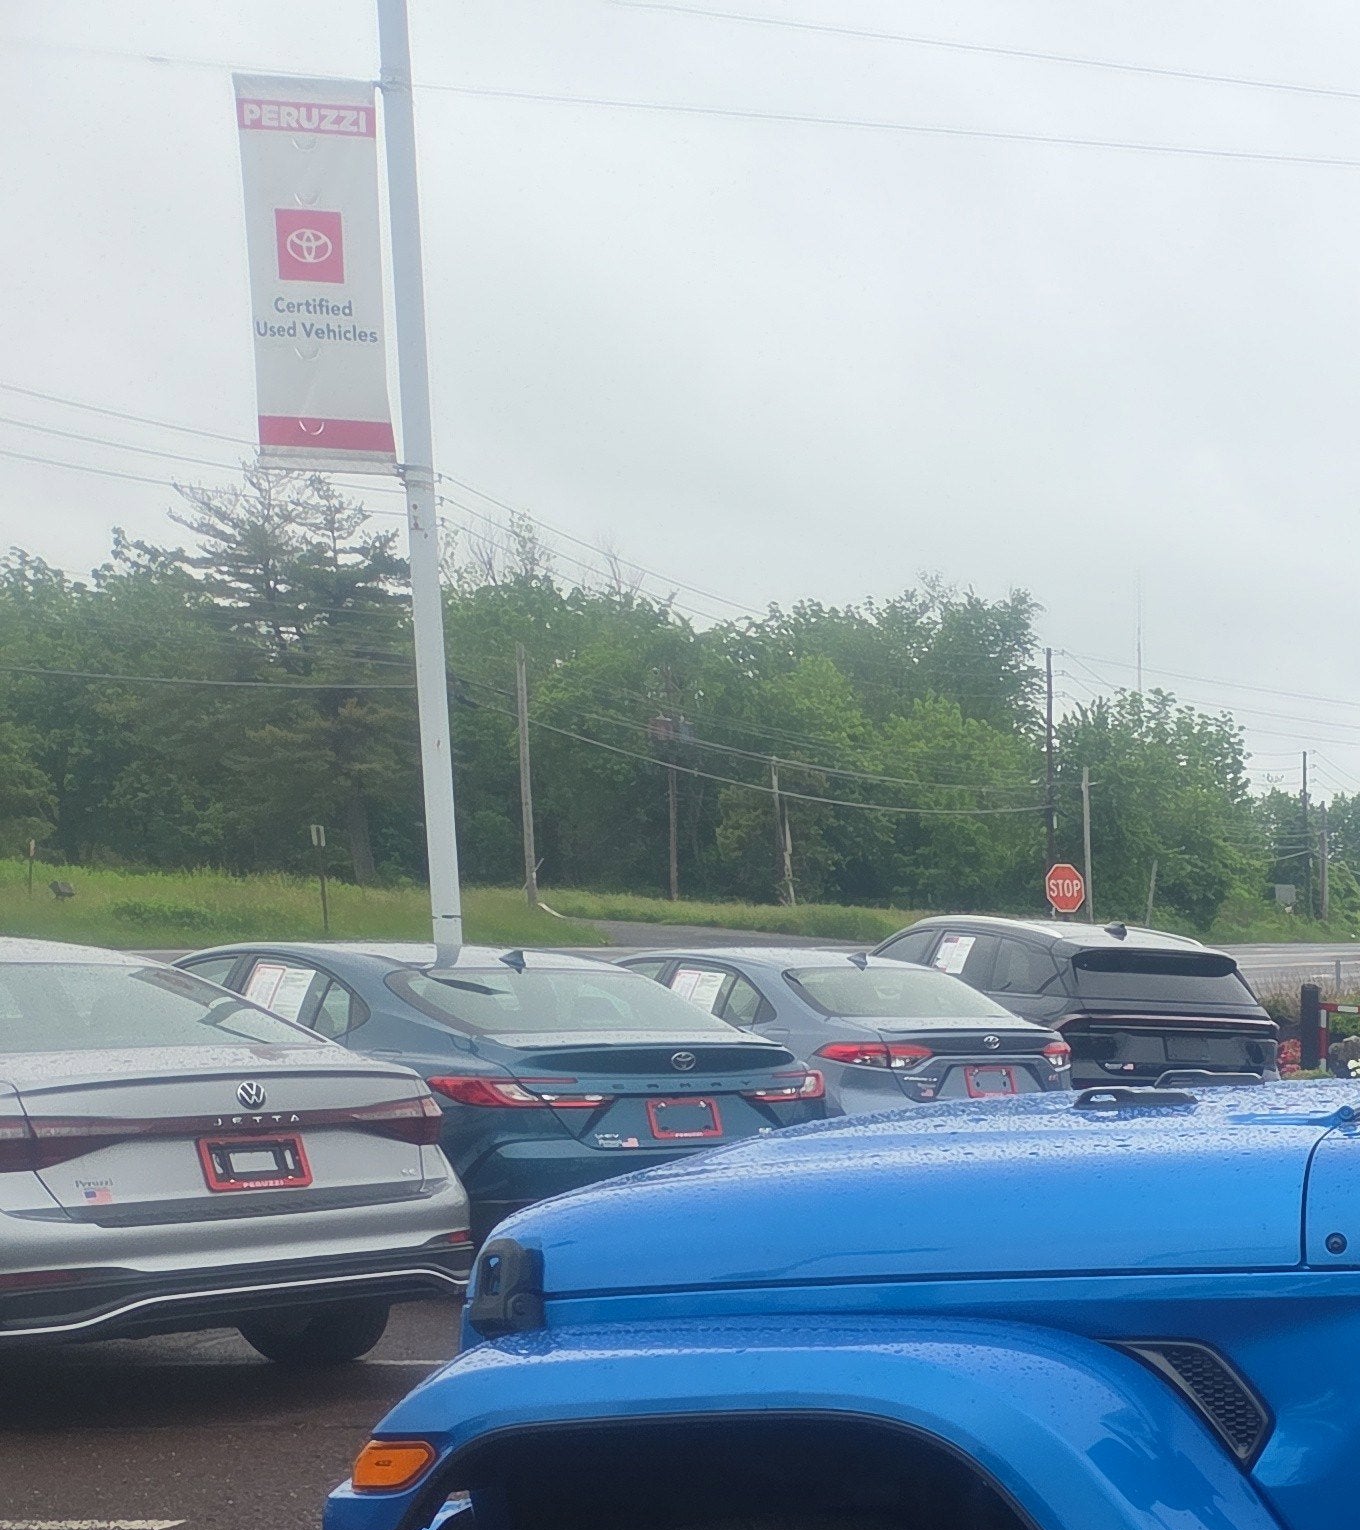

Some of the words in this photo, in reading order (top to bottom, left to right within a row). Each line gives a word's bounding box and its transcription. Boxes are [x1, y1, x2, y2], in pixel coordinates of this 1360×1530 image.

[243, 104, 367, 133] PERUZZI
[273, 296, 353, 317] Certified
[256, 320, 297, 338] Used
[301, 322, 378, 343] Vehicles
[1050, 879, 1081, 897] STOP
[214, 1114, 300, 1127] JETTA
